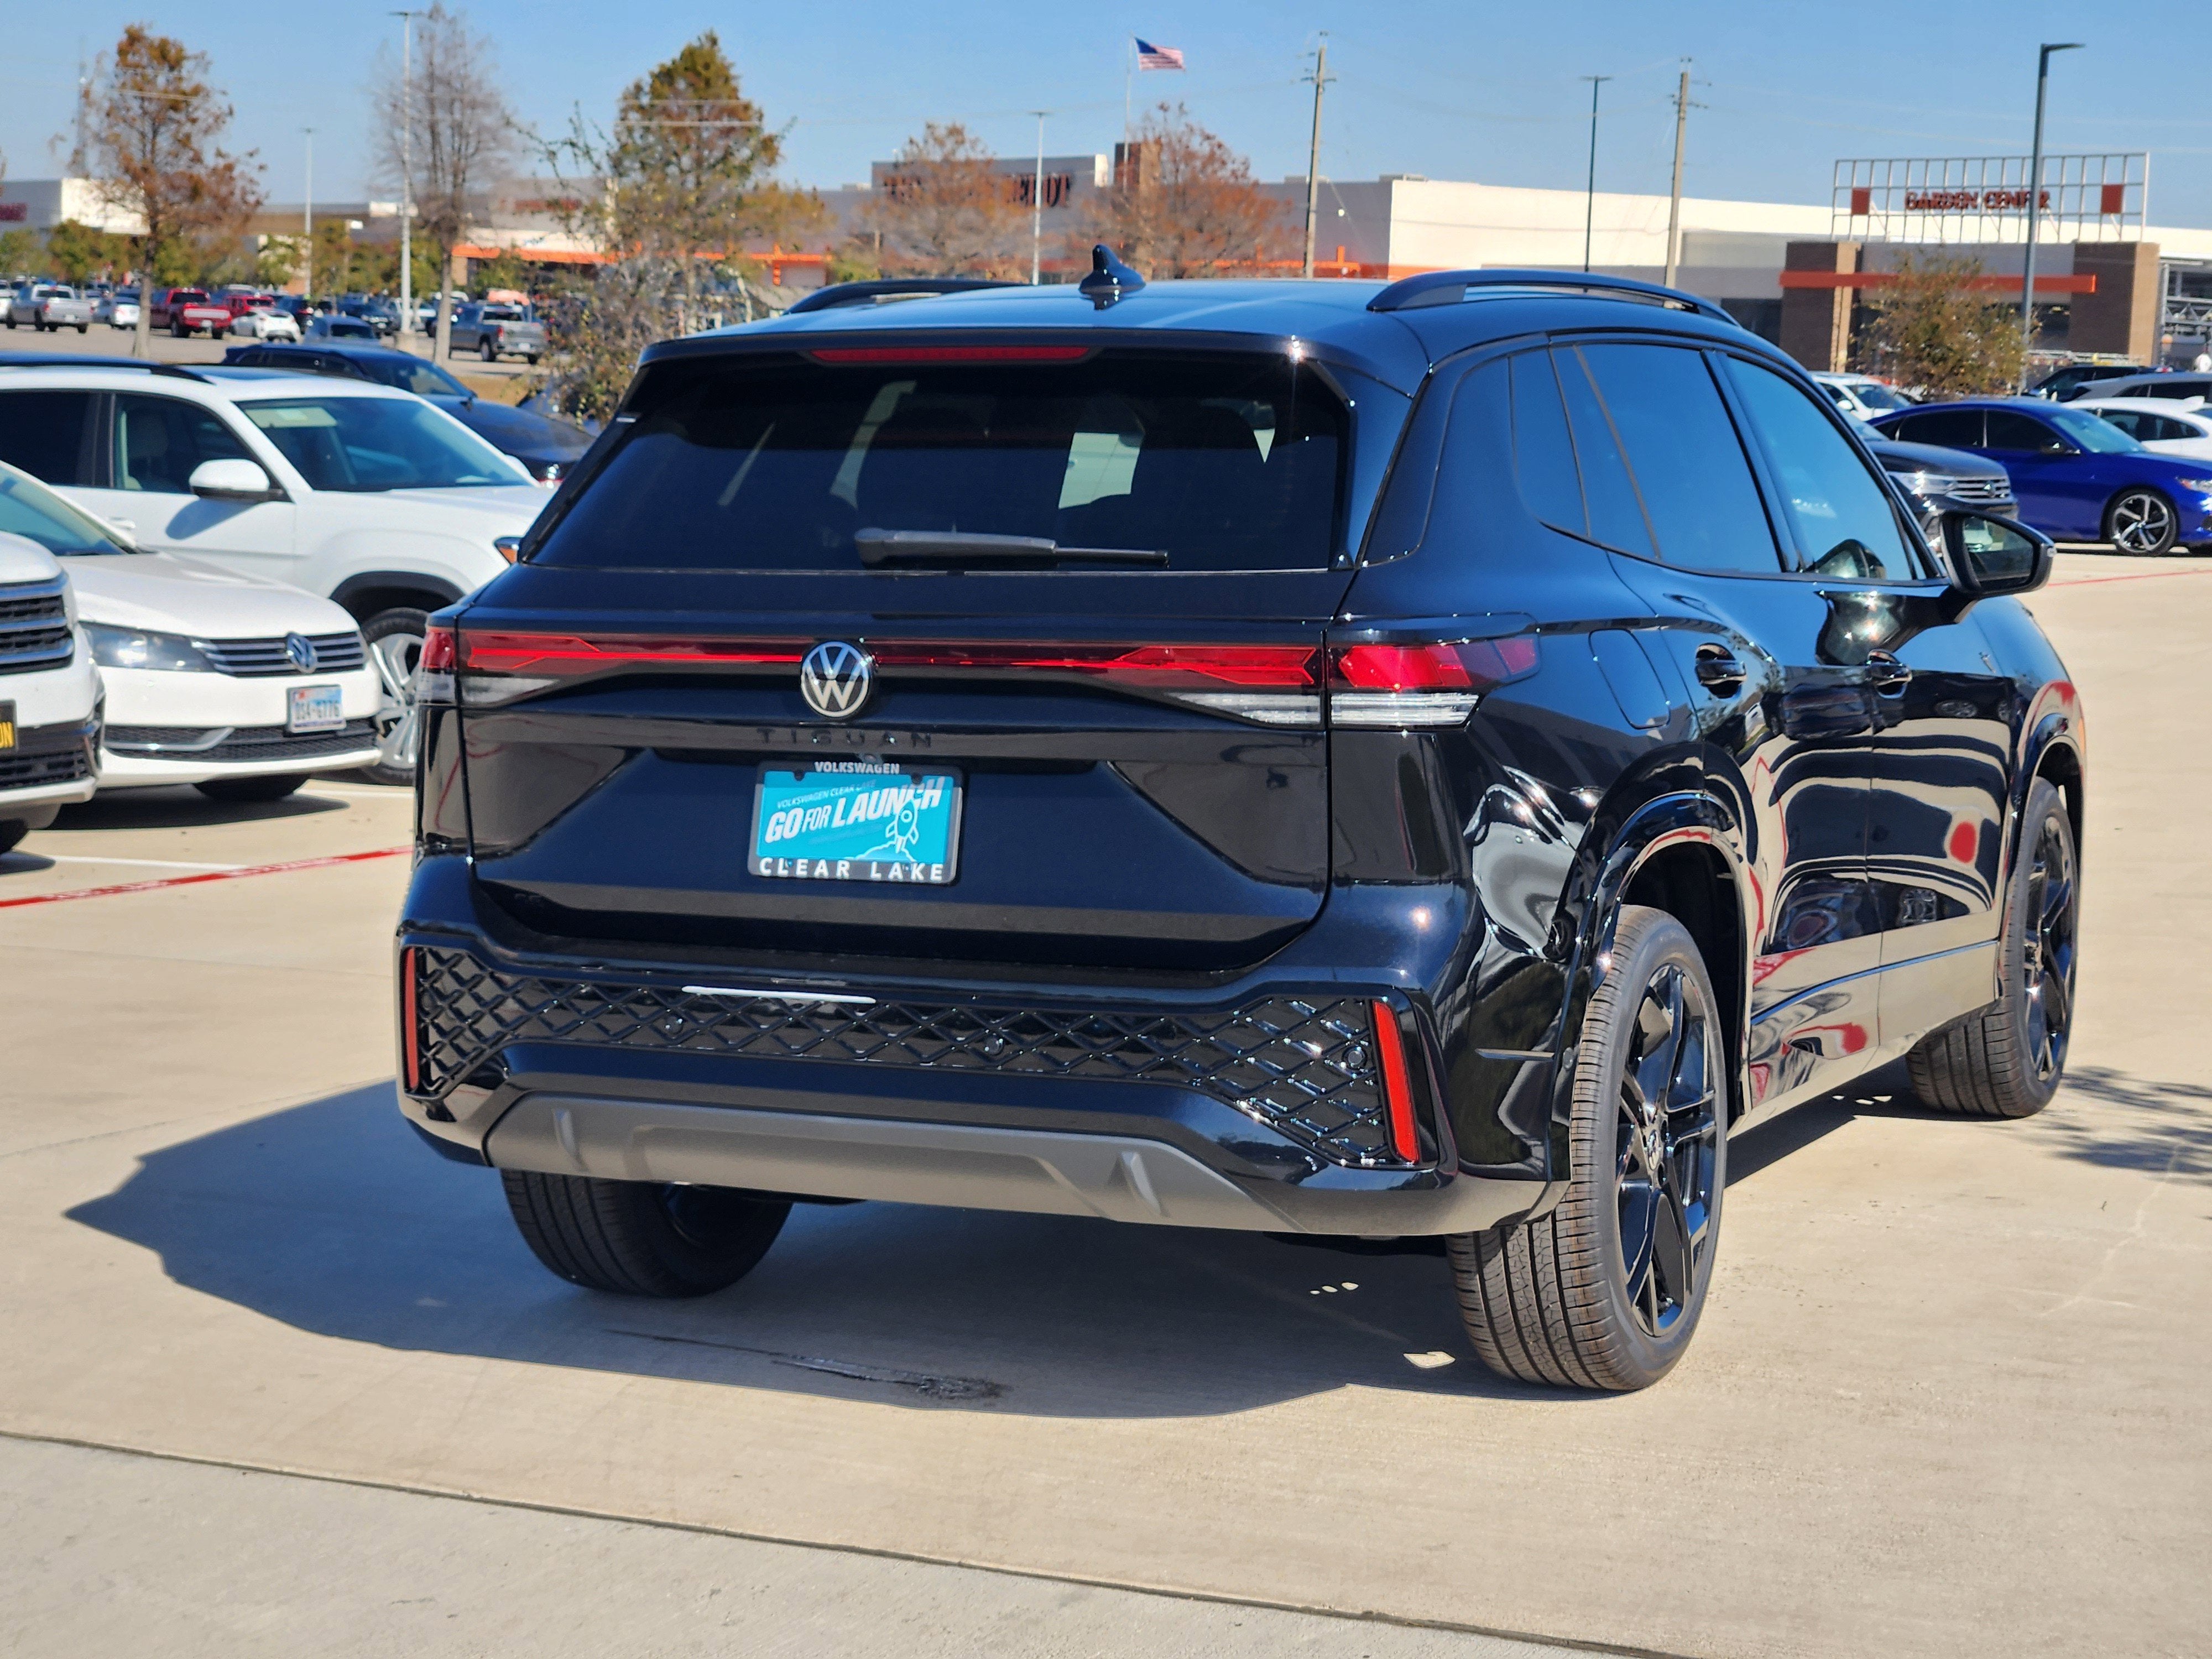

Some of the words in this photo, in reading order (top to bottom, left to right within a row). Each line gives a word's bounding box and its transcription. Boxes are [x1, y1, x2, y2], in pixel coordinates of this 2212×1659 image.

[1905, 191, 1978, 210] GARDEN
[1985, 190, 2051, 209] CENTR
[755, 727, 932, 748] TIGUAN
[814, 761, 900, 774] VOLKSWAGEN
[830, 784, 855, 797] CLEAR
[765, 807, 804, 843] GO
[801, 805, 832, 832] FOR
[831, 776, 945, 828] LAUNCH
[759, 857, 850, 878] CLEAR
[870, 861, 944, 881] LAKE
